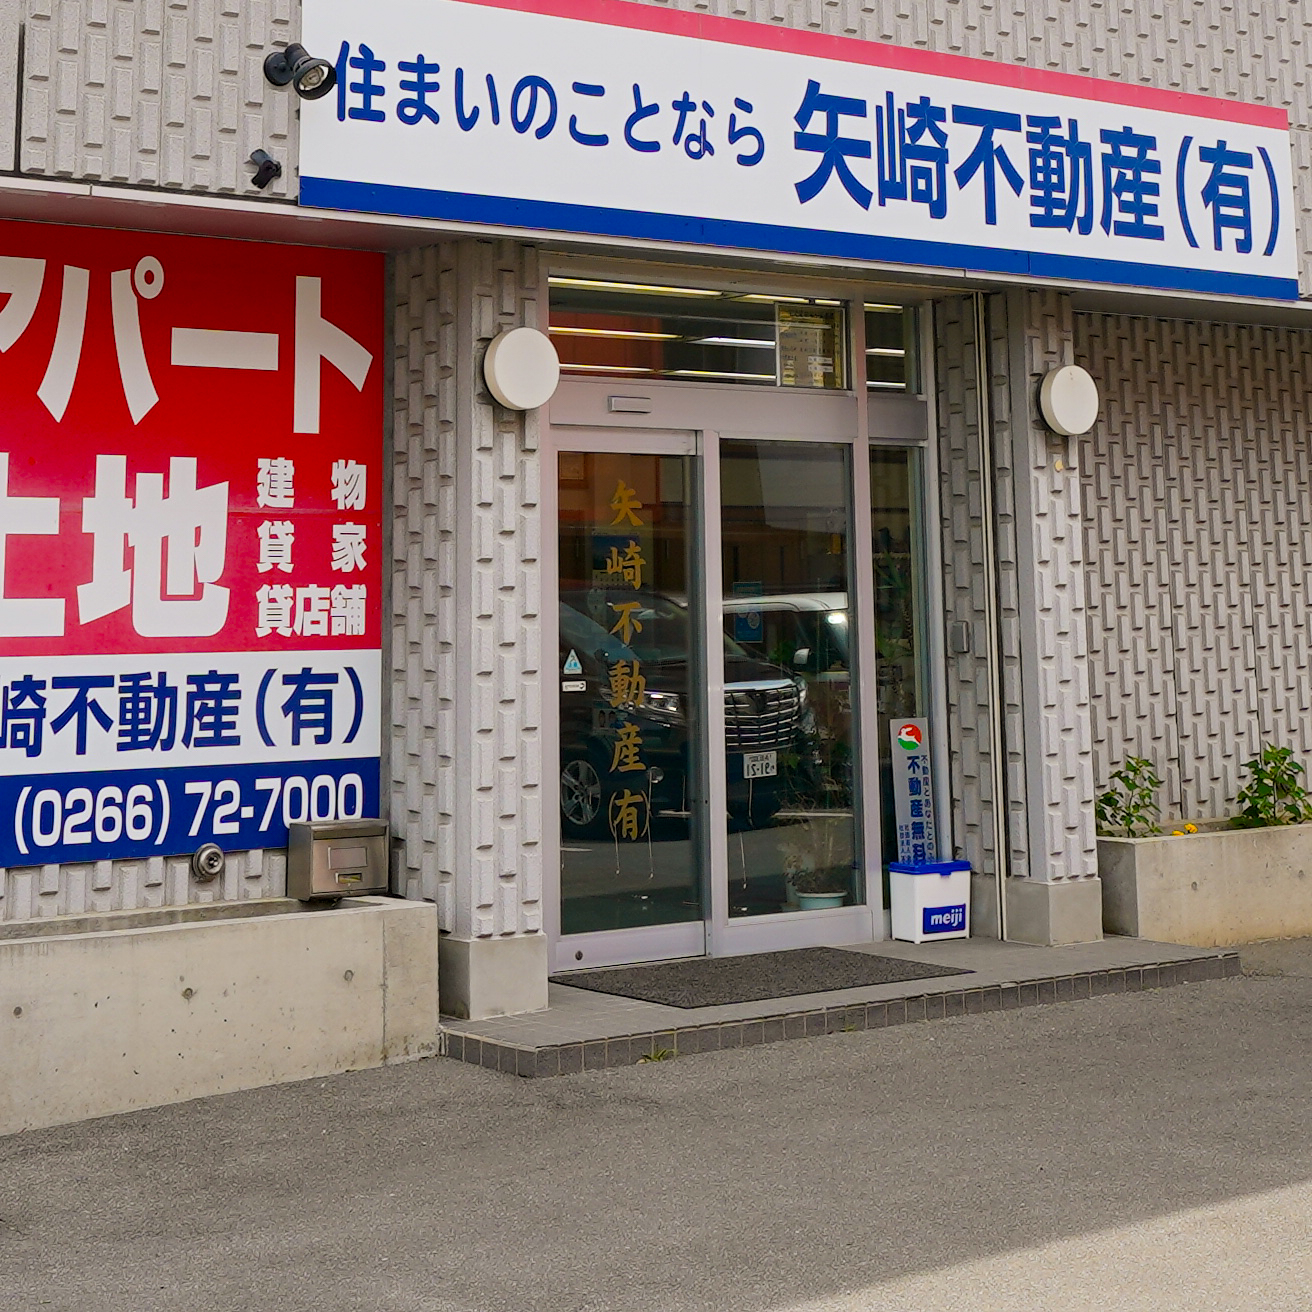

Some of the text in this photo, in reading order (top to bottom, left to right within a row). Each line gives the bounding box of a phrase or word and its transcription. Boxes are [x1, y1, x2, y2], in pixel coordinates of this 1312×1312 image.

[334, 40, 1280, 257] 住まいのことなら 矢崎不動産(有)
[255, 584, 368, 637] 貸店舗
[606, 480, 649, 840] 矢崎不動産(有)
[14, 779, 170, 855] (0266)
[184, 772, 364, 838] 72-7000
[930, 908, 963, 927] meiji
